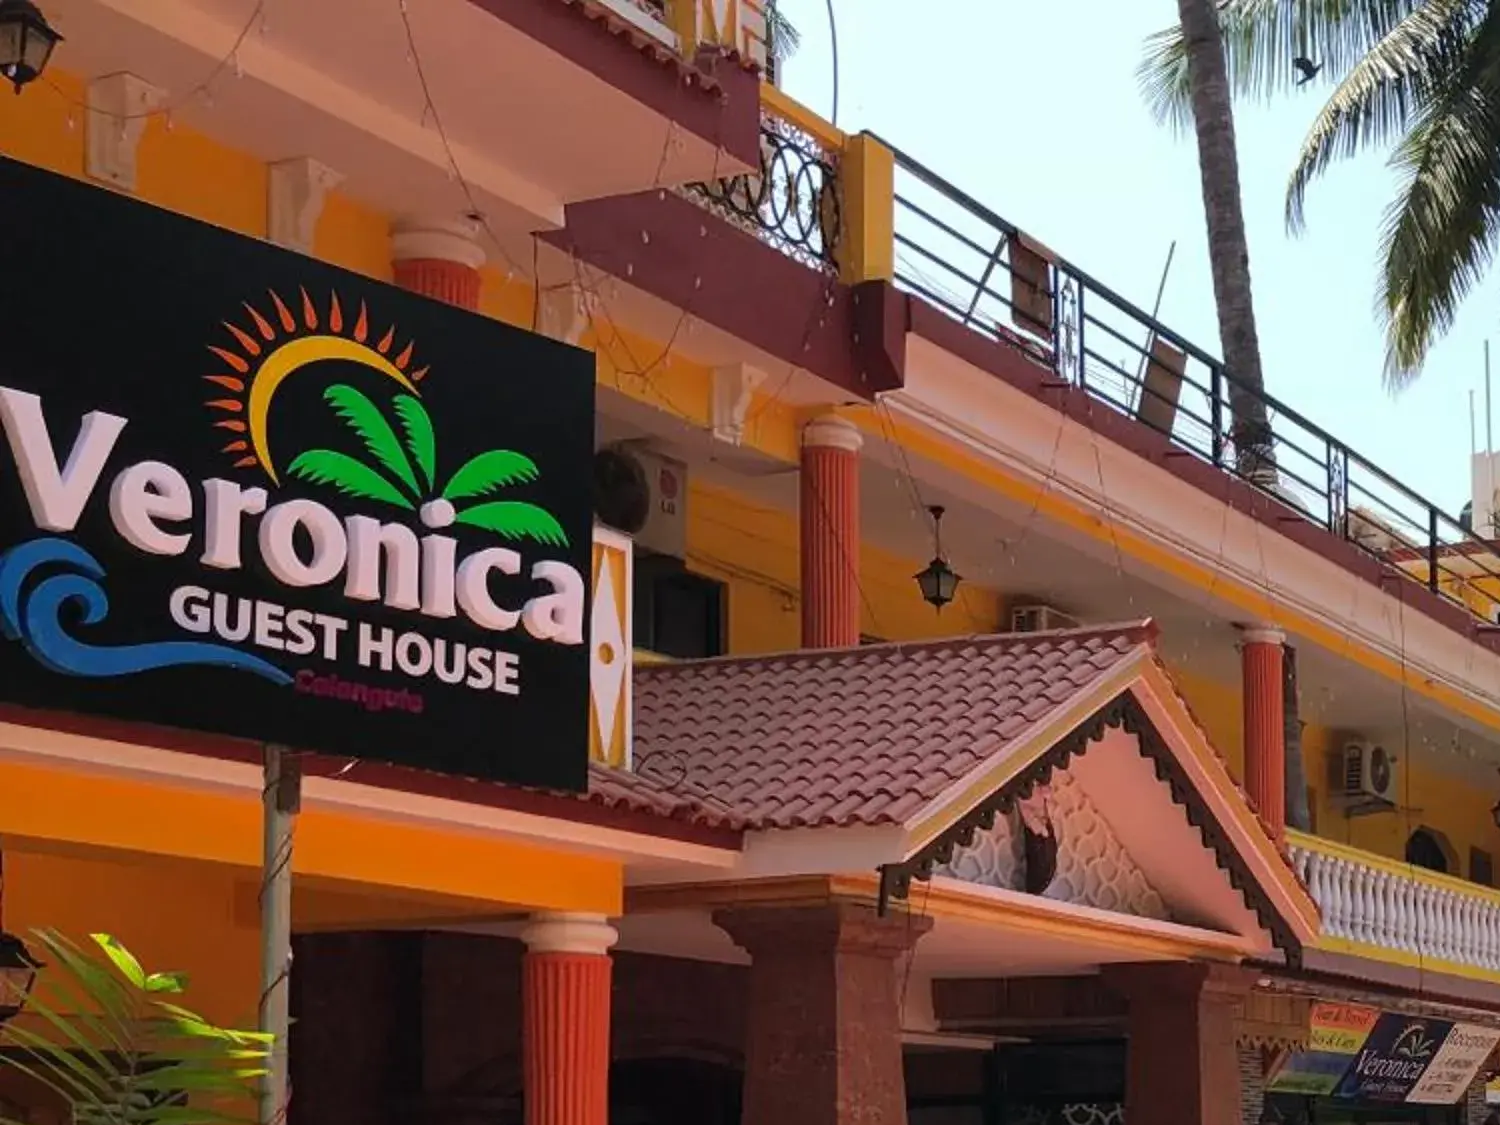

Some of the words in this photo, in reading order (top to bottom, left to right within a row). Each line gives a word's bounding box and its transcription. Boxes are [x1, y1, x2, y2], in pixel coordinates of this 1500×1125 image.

[0, 386, 585, 645] Veronica
[168, 585, 349, 662] GUEST
[358, 621, 521, 695] HOUSE
[1356, 1048, 1425, 1080] Veronica
